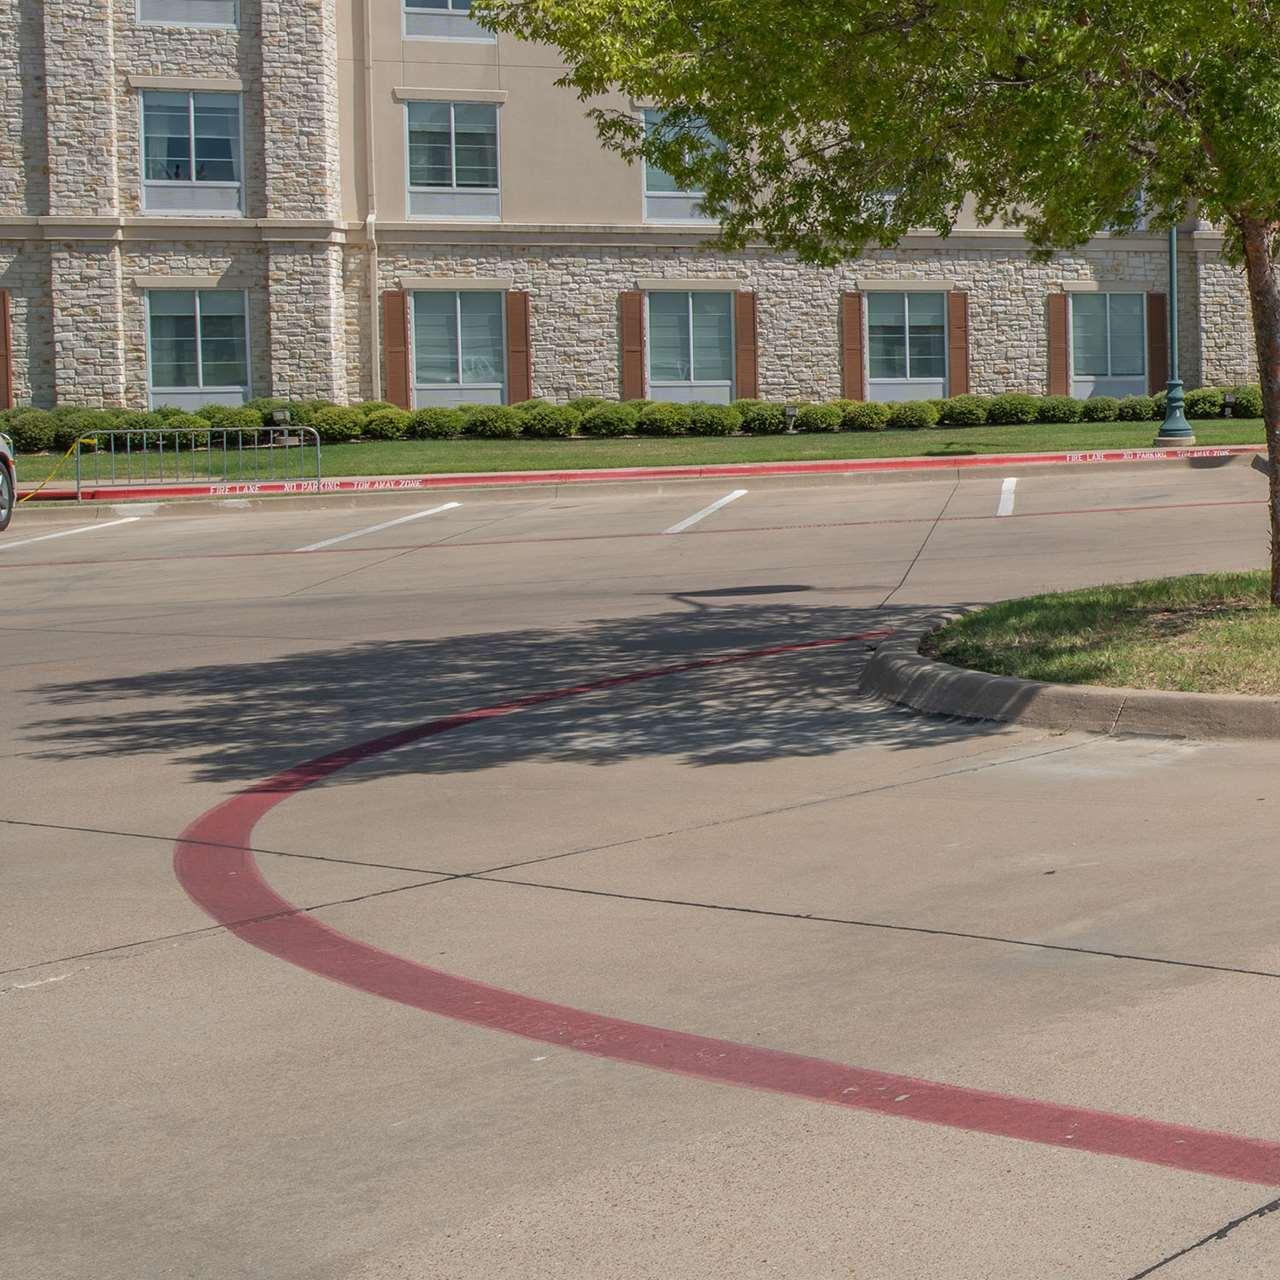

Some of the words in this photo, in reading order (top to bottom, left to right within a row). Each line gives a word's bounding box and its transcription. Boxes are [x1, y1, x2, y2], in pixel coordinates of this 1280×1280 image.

[209, 485, 230, 495] FIRE
[236, 484, 260, 494] LANE
[283, 483, 297, 493] NO
[301, 480, 341, 492] PARKING
[373, 480, 395, 489] AWAY
[399, 479, 422, 488] ZONE
